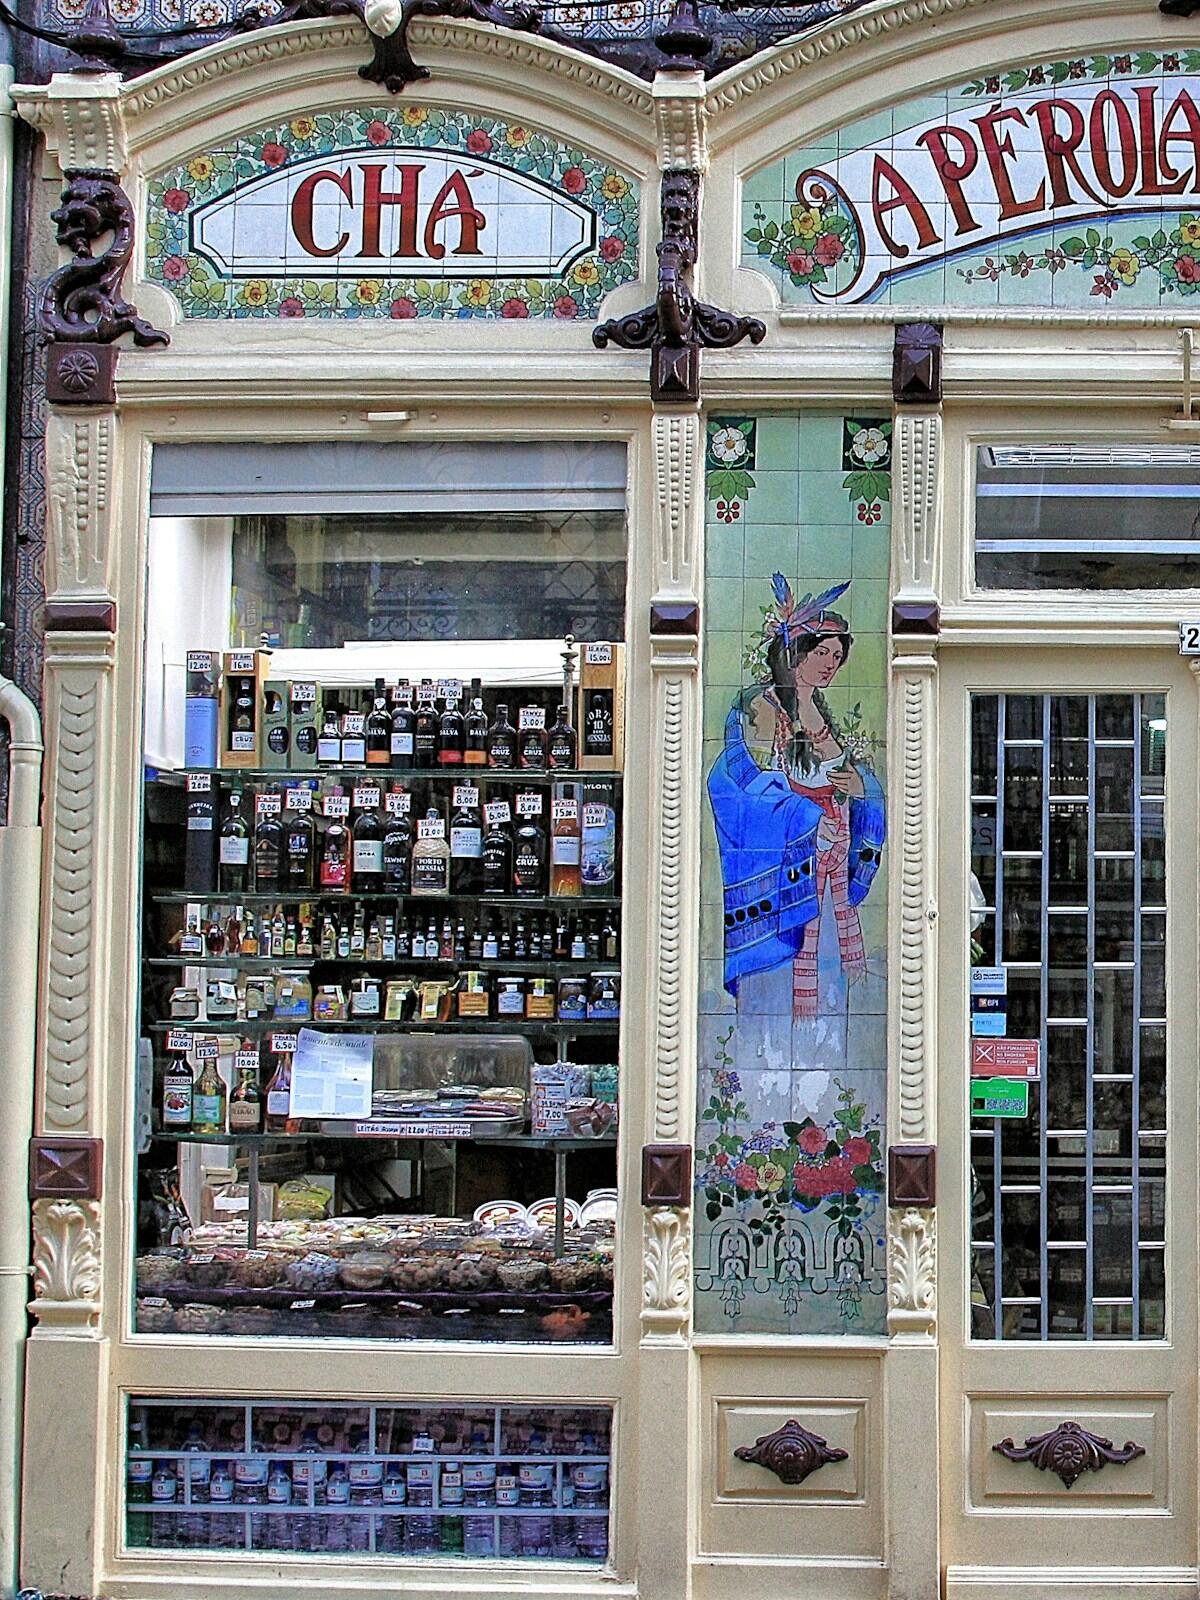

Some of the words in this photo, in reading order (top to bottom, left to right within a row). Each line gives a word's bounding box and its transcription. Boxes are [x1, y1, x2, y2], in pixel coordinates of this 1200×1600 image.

[872, 152, 943, 259] A
[291, 164, 487, 260] CHÁ
[593, 720, 603, 730] 10
[551, 748, 571, 756] CRUZ
[515, 858, 540, 866] CRUZ
[987, 999, 999, 1007] BPI
